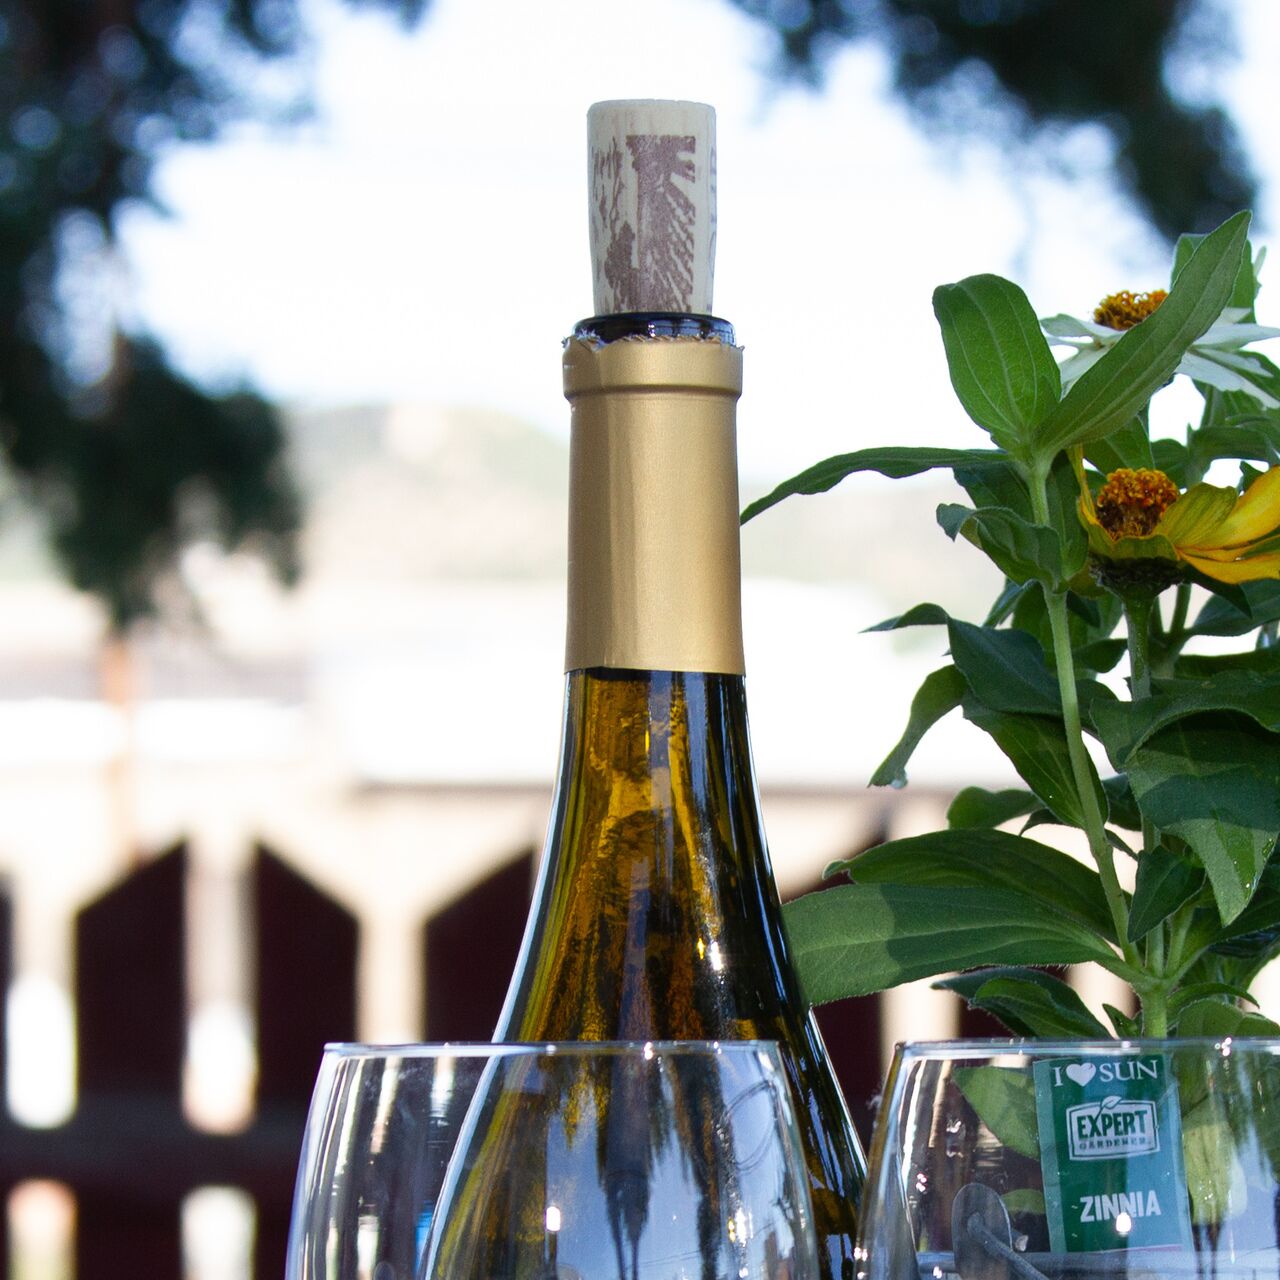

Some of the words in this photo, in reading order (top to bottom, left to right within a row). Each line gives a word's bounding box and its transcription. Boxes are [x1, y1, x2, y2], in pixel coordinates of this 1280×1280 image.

[1052, 1066, 1064, 1087] I
[1099, 1059, 1159, 1083] SUN
[1077, 1110, 1148, 1140] EXPERT
[1079, 1190, 1162, 1223] ZINNIA
